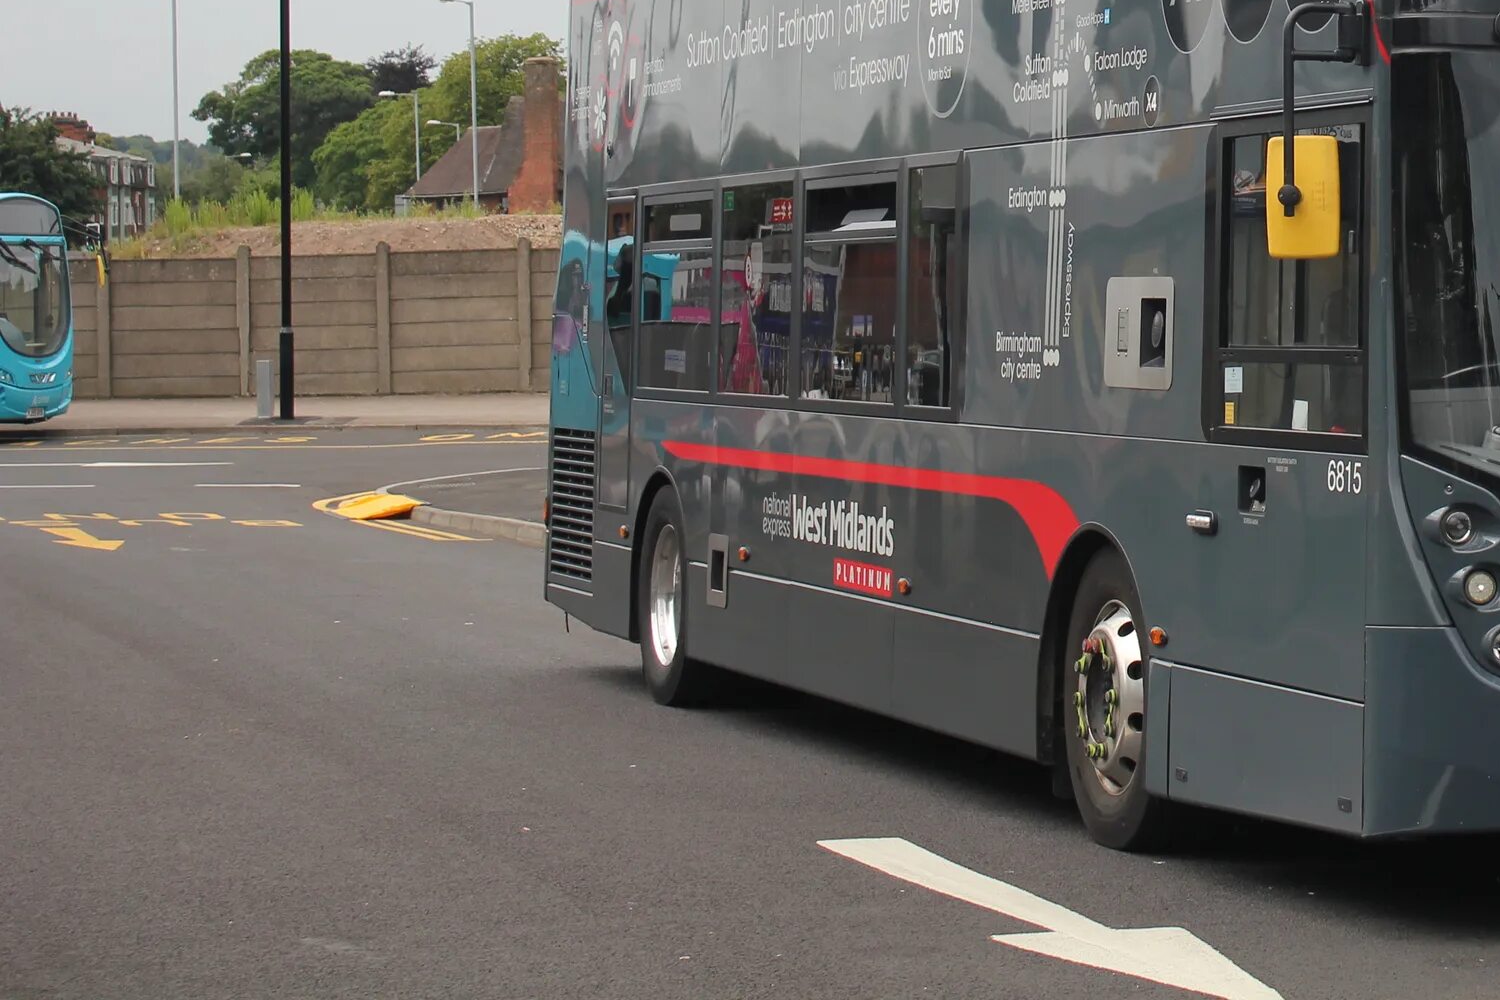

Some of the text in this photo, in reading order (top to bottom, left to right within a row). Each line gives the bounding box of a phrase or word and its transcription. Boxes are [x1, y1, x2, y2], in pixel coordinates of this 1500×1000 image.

[686, 31, 720, 69] Sutton
[722, 16, 768, 60] Coldfield
[777, 4, 834, 53] Erdington
[928, 23, 964, 58] 6 mins
[1025, 53, 1051, 76] Sutton
[1094, 45, 1148, 72] Falcon Lodge
[833, 53, 909, 94] via Expressway
[1013, 77, 1050, 103] Coldfield
[1104, 92, 1157, 120] Minworth X4
[1008, 186, 1047, 213] Erdington
[1062, 222, 1076, 337] Expressway
[996, 331, 1042, 358] Birmingham
[1001, 358, 1041, 383] city centre
[1327, 459, 1362, 494] 6815
[762, 492, 791, 517] national
[762, 516, 790, 541] express
[792, 494, 895, 557] West Midlands
[836, 562, 891, 591] PLATINUM
